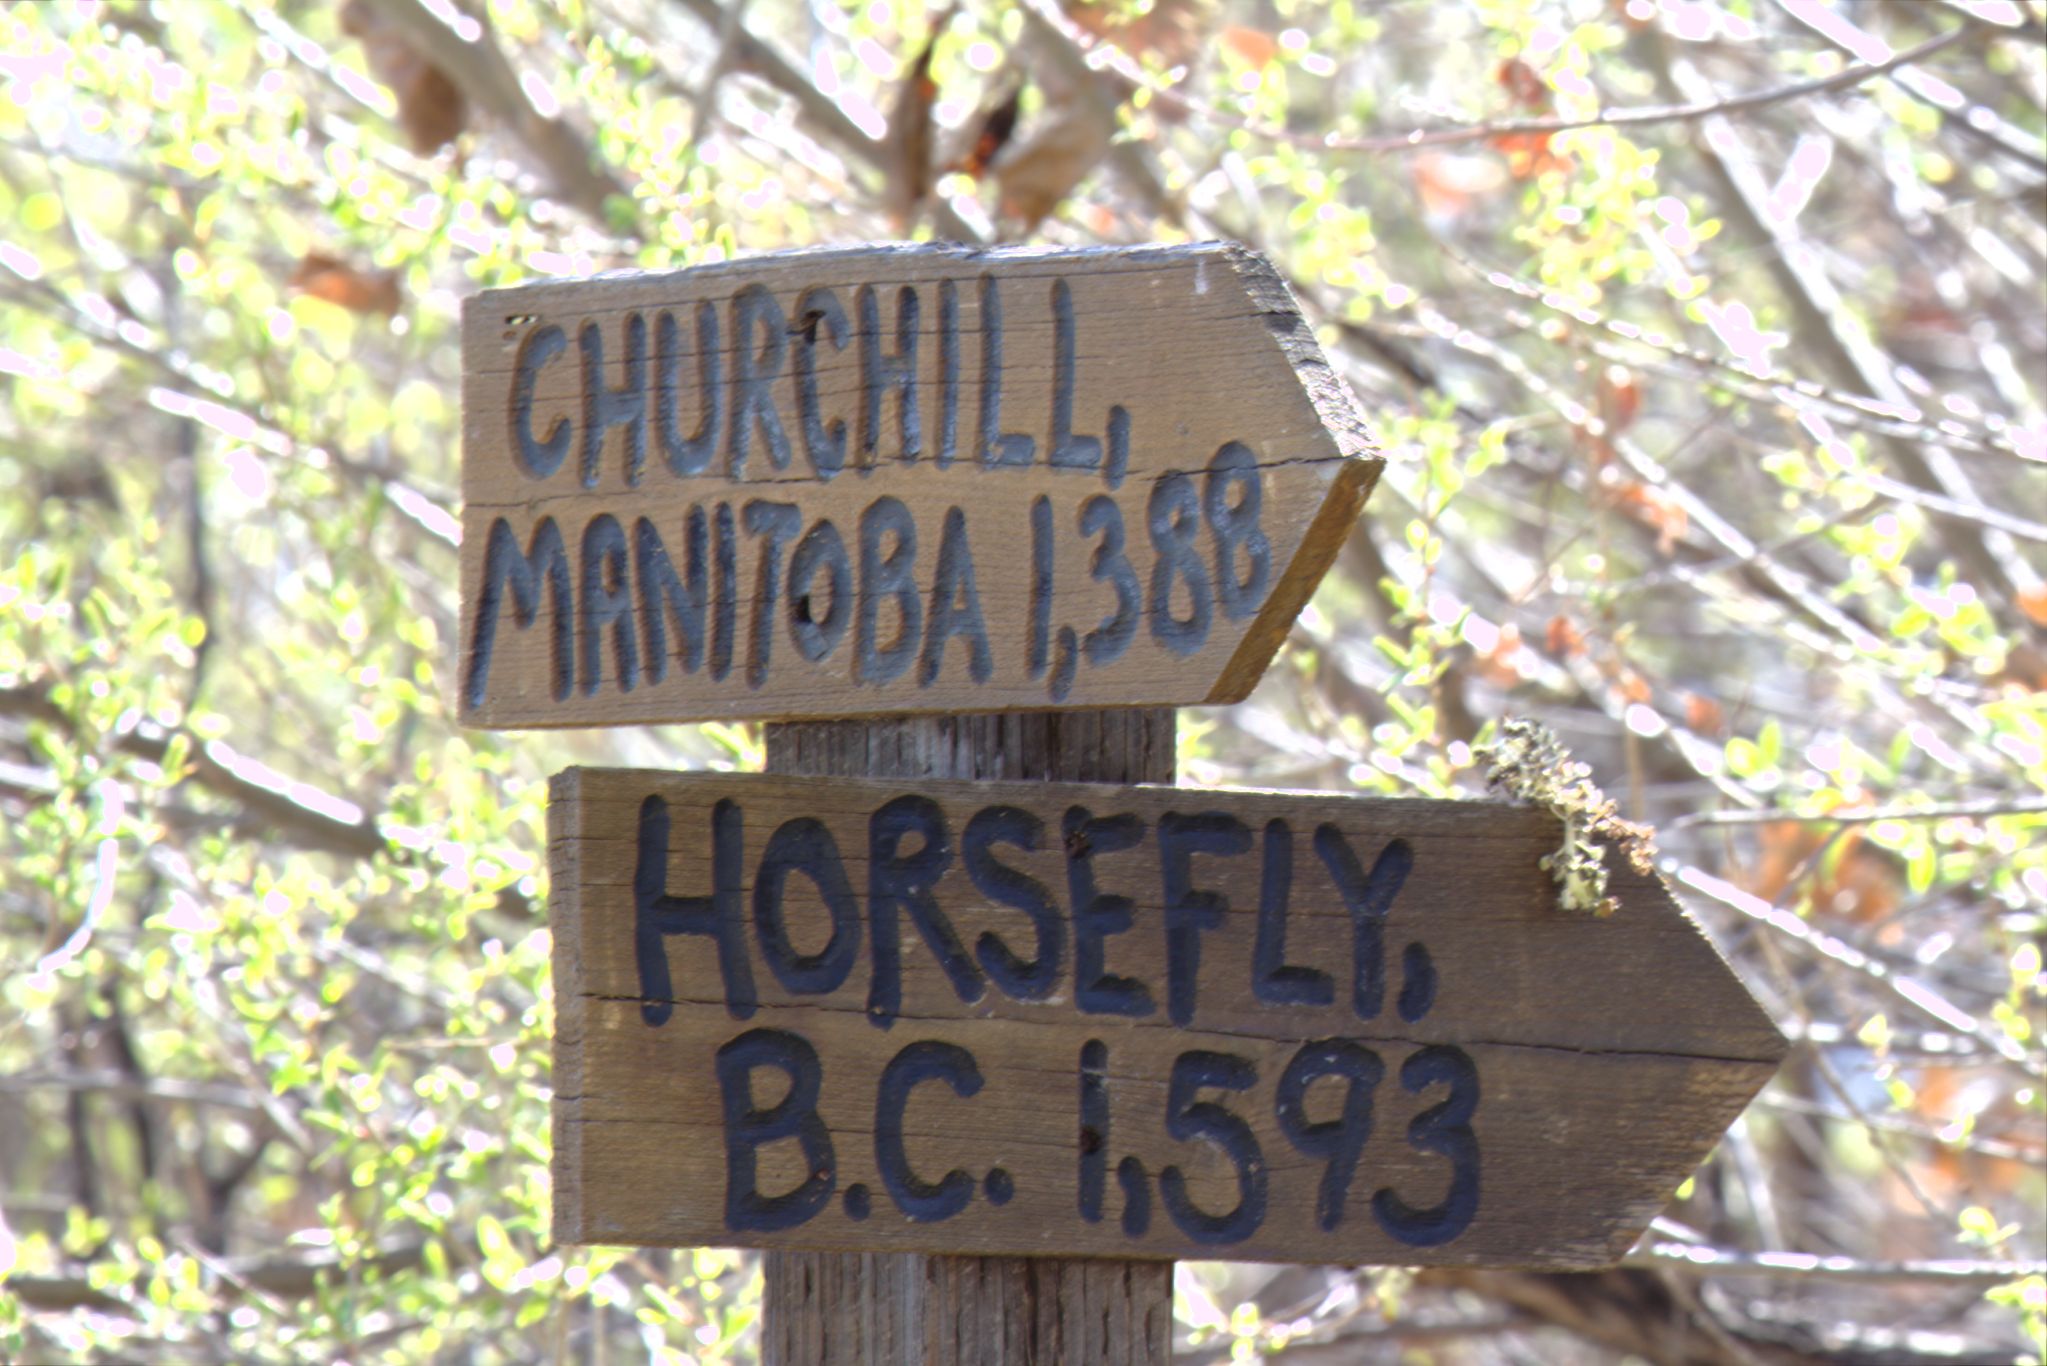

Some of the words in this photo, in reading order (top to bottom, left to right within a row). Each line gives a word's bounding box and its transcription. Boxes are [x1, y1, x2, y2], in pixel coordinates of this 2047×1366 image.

[508, 272, 1131, 490] CHURCHILL,
[465, 495, 993, 709] MANITOBA
[1026, 440, 1273, 703] 1,388
[633, 794, 1438, 1031] HORSEFLY,
[715, 1028, 1015, 1232] B.C.
[1077, 1037, 1482, 1247] 1,593
